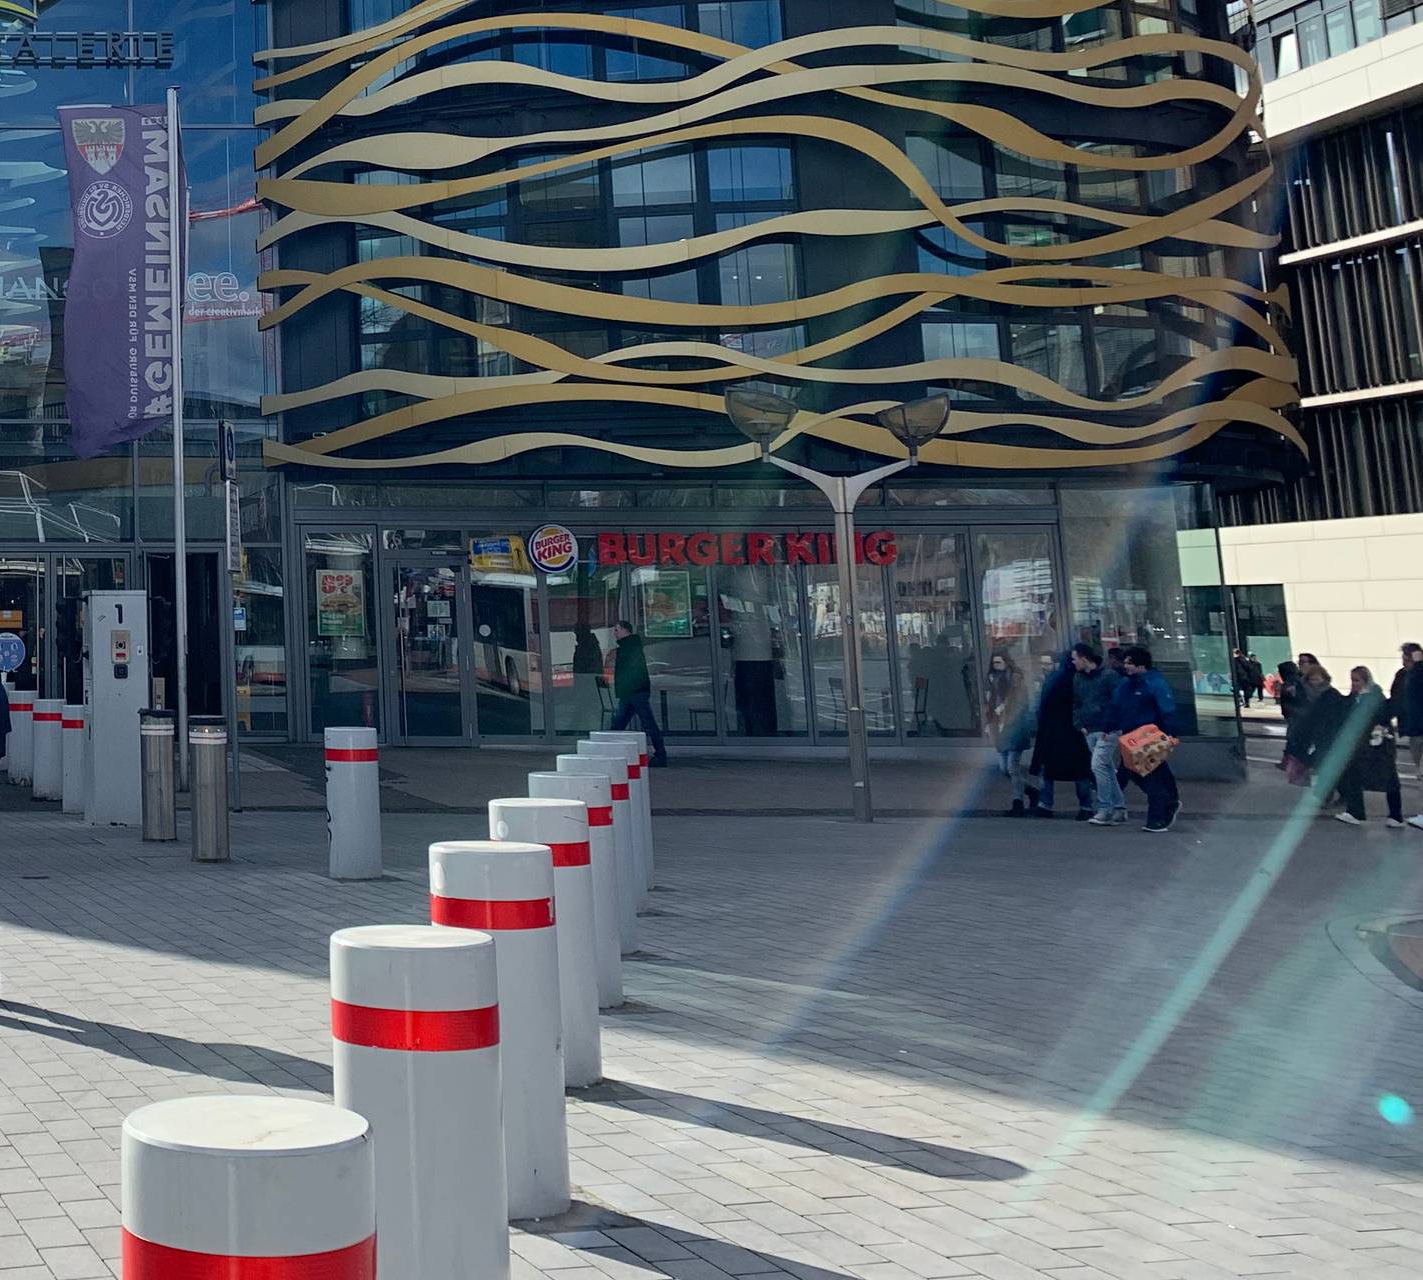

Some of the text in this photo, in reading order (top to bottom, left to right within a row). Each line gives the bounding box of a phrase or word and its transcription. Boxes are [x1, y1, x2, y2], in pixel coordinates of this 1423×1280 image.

[534, 533, 571, 551] BURGER
[537, 541, 573, 562] KING
[598, 531, 776, 566] BURGER
[114, 603, 123, 624] 1
